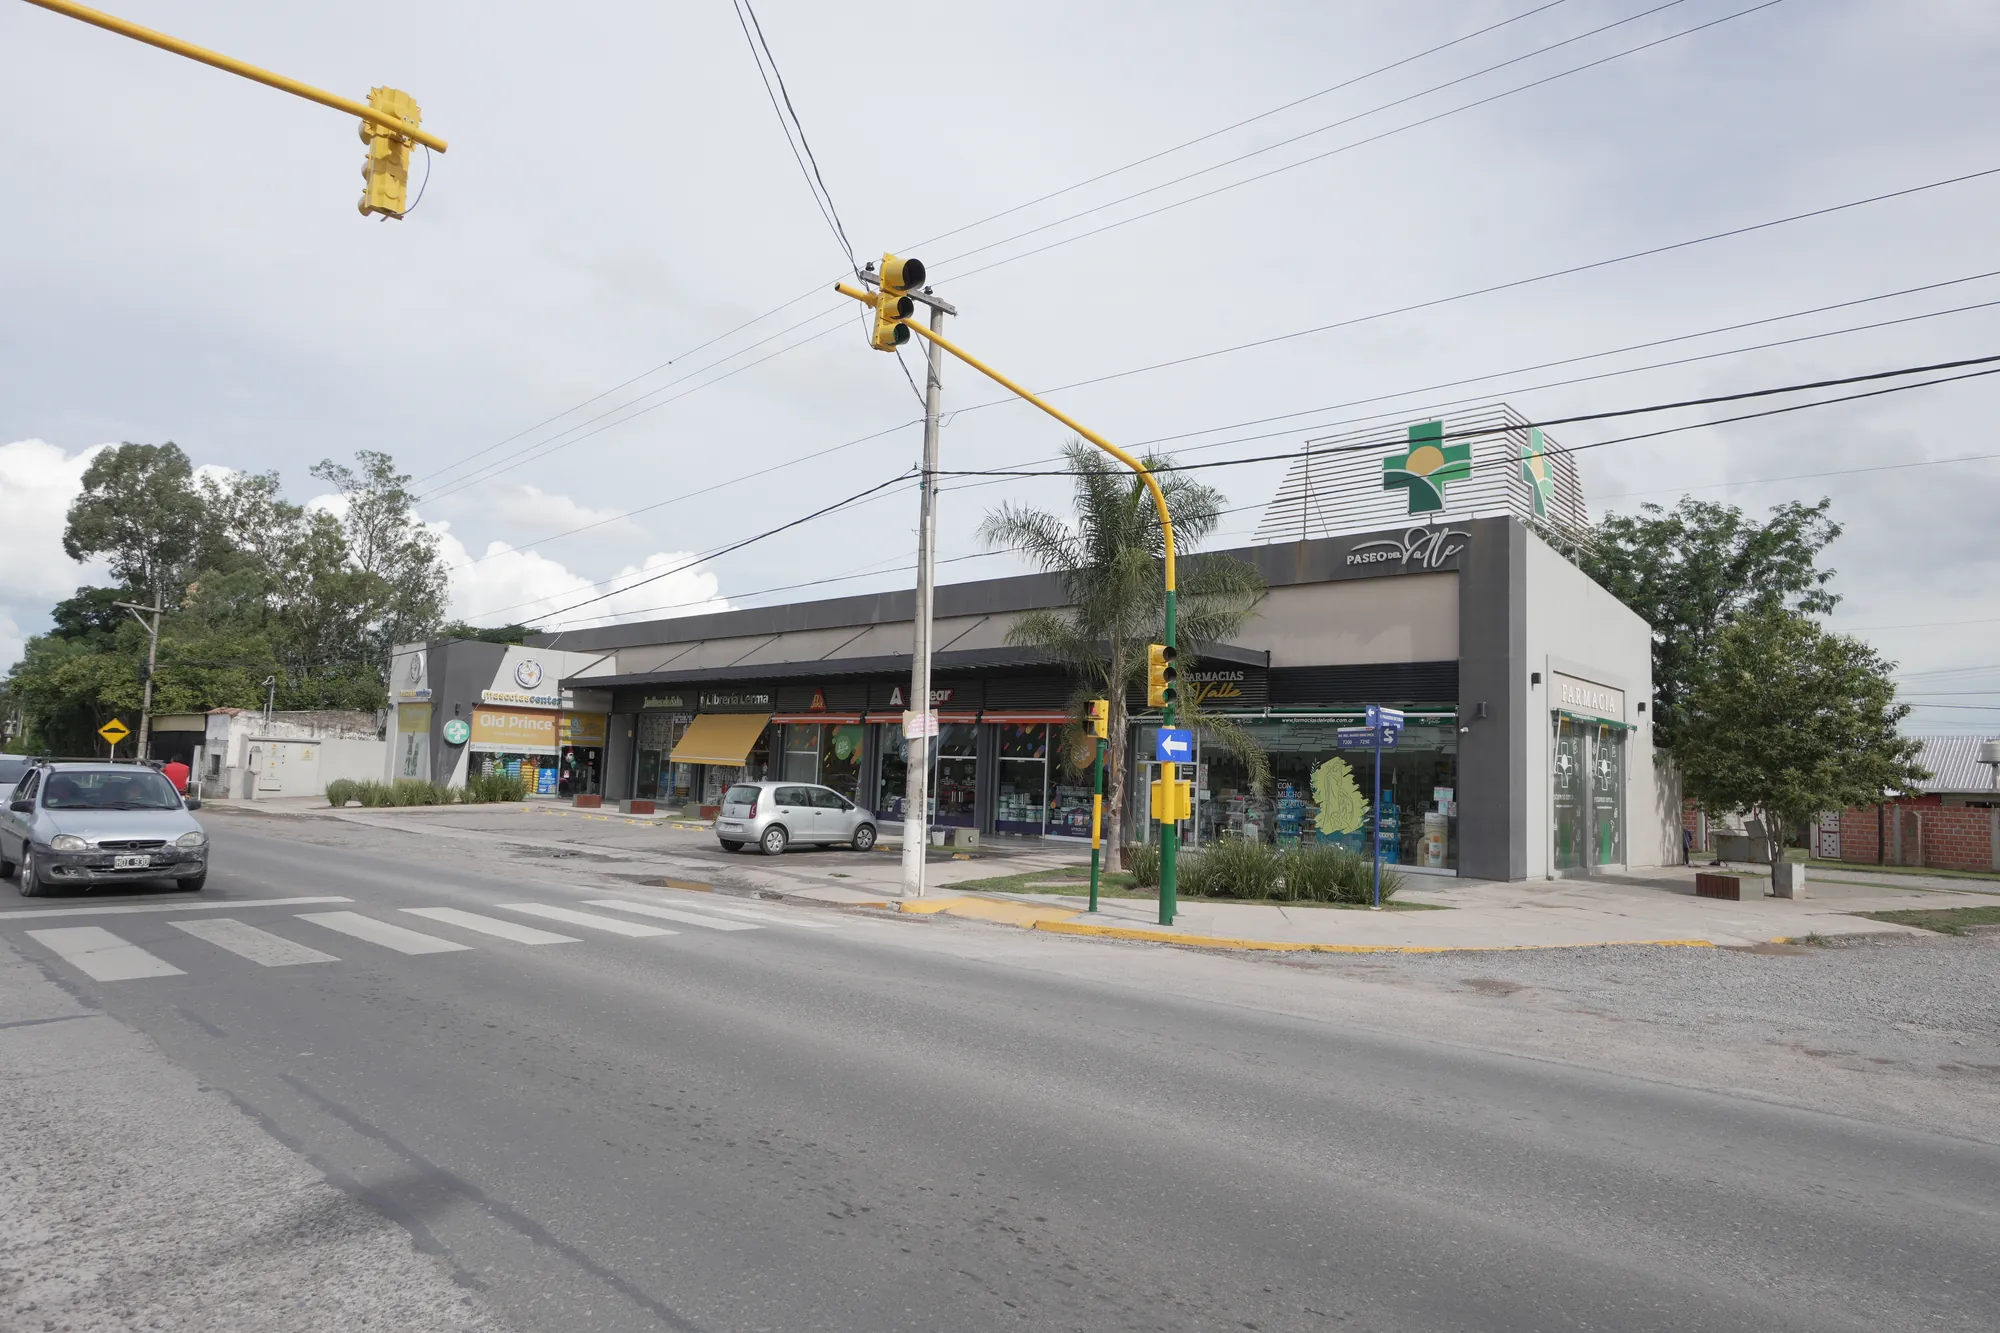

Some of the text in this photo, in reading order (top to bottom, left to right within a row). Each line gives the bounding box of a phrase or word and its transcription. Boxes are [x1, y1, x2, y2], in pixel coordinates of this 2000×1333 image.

[1346, 526, 1472, 568] PASEO DEL Valle
[740, 694, 769, 705] Lerma
[1190, 681, 1242, 705] Valle
[1561, 683, 1616, 714] FARMACIA
[480, 713, 554, 731] Old Prince
[1277, 790, 1303, 798] MUCHO
